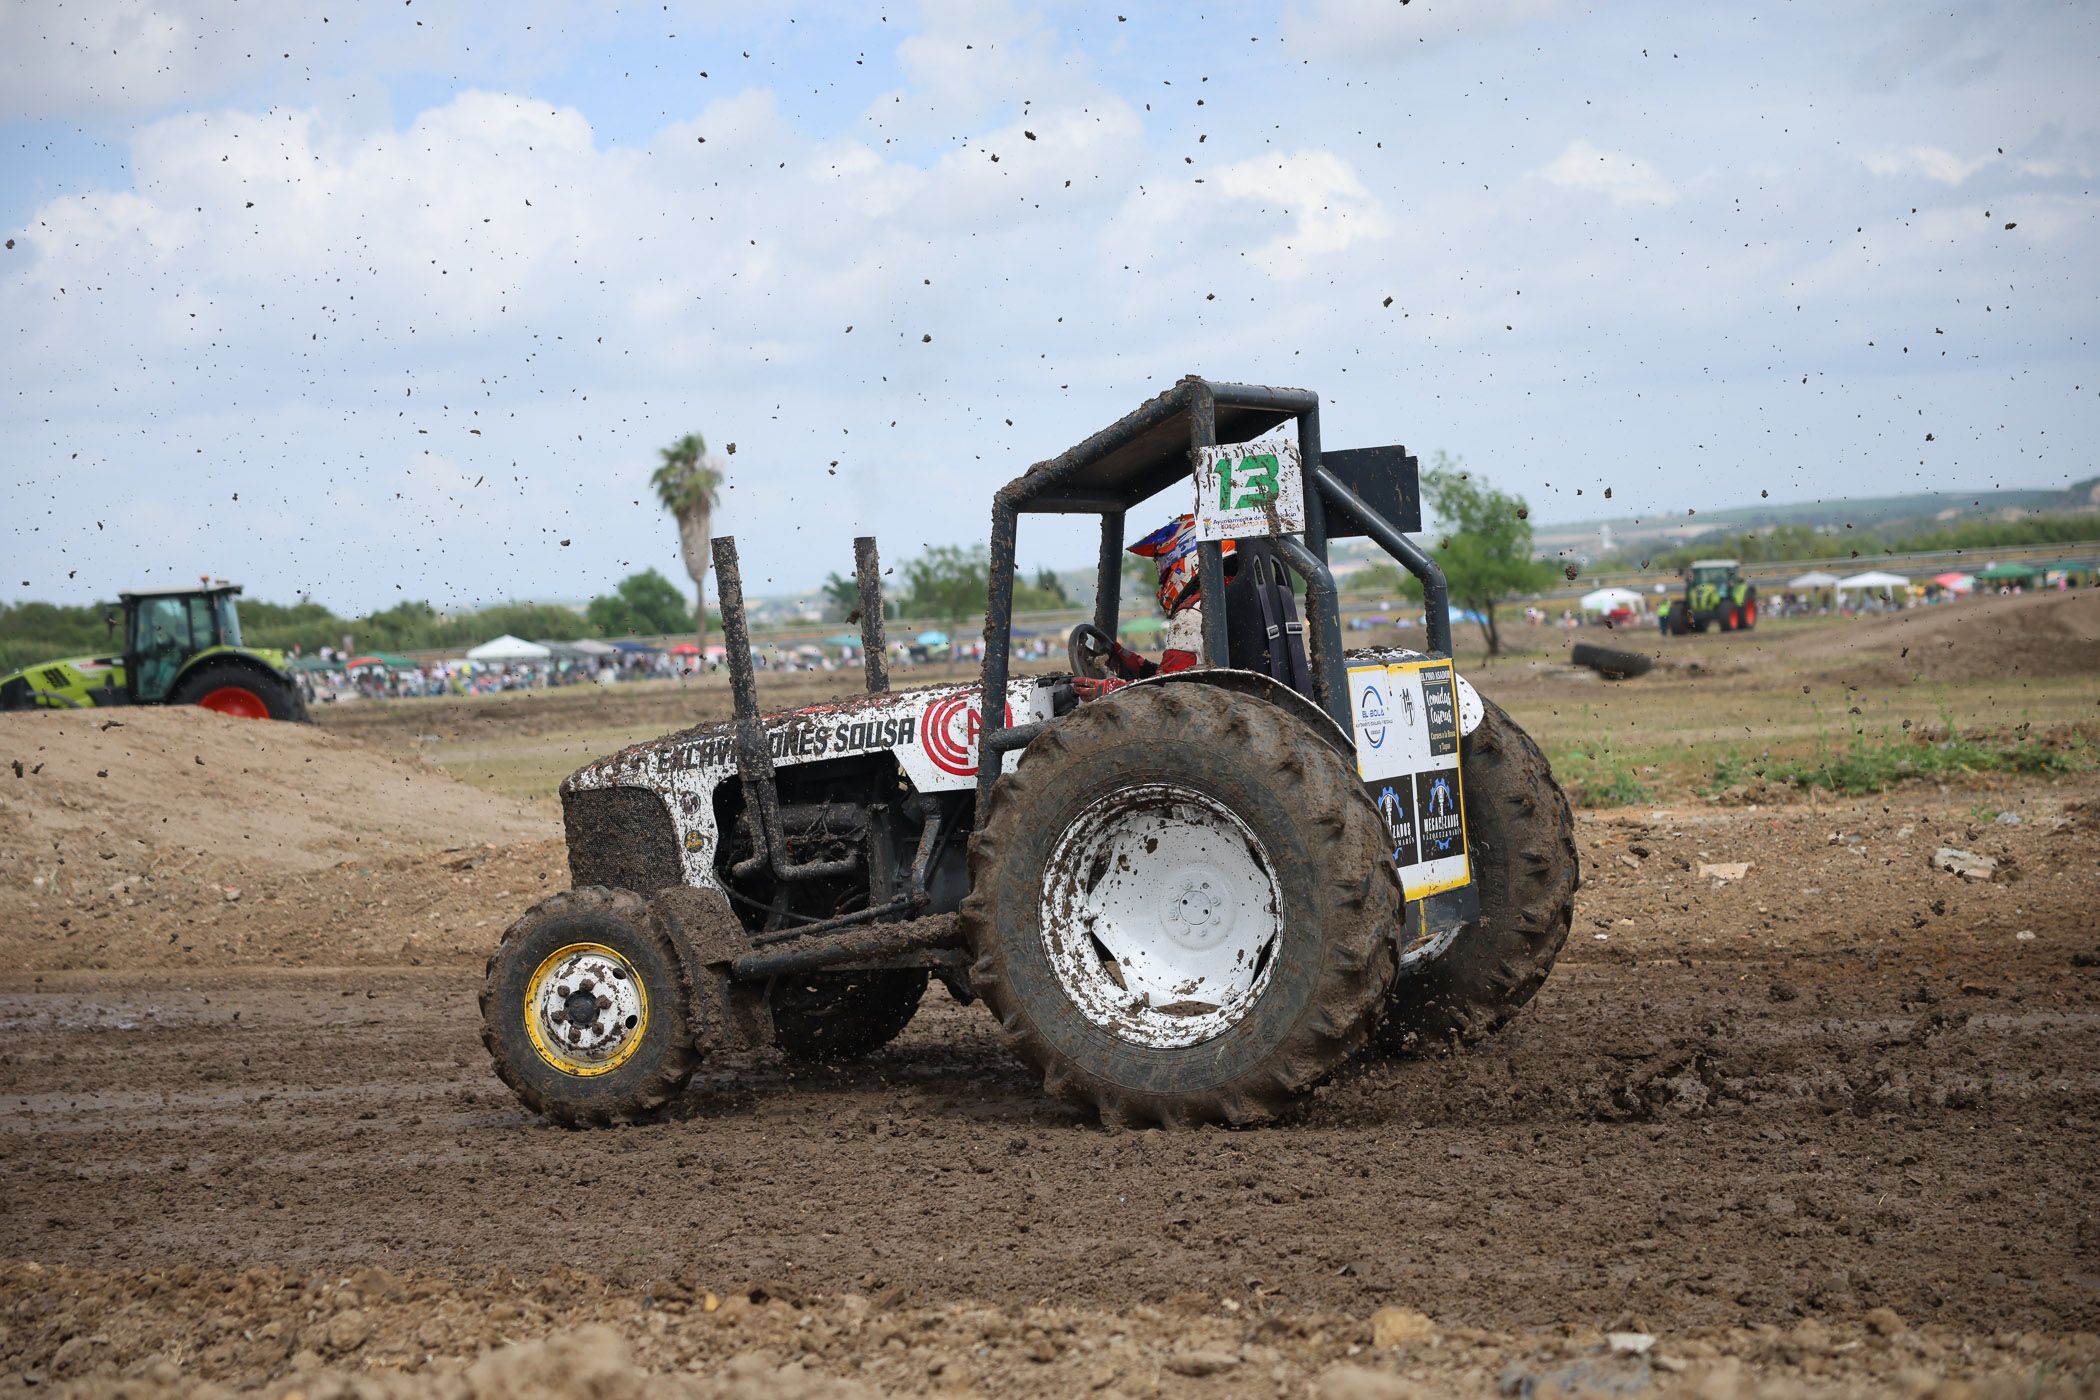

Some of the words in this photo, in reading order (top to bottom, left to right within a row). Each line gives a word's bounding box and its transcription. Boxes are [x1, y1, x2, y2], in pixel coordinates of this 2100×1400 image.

[1213, 453, 1279, 511] 13
[1426, 687, 1451, 706] Comidas
[1362, 710, 1368, 718] EL
[1369, 708, 1384, 717] BOLA
[1430, 707, 1451, 724] Caseras
[835, 717, 916, 752] SOUSA
